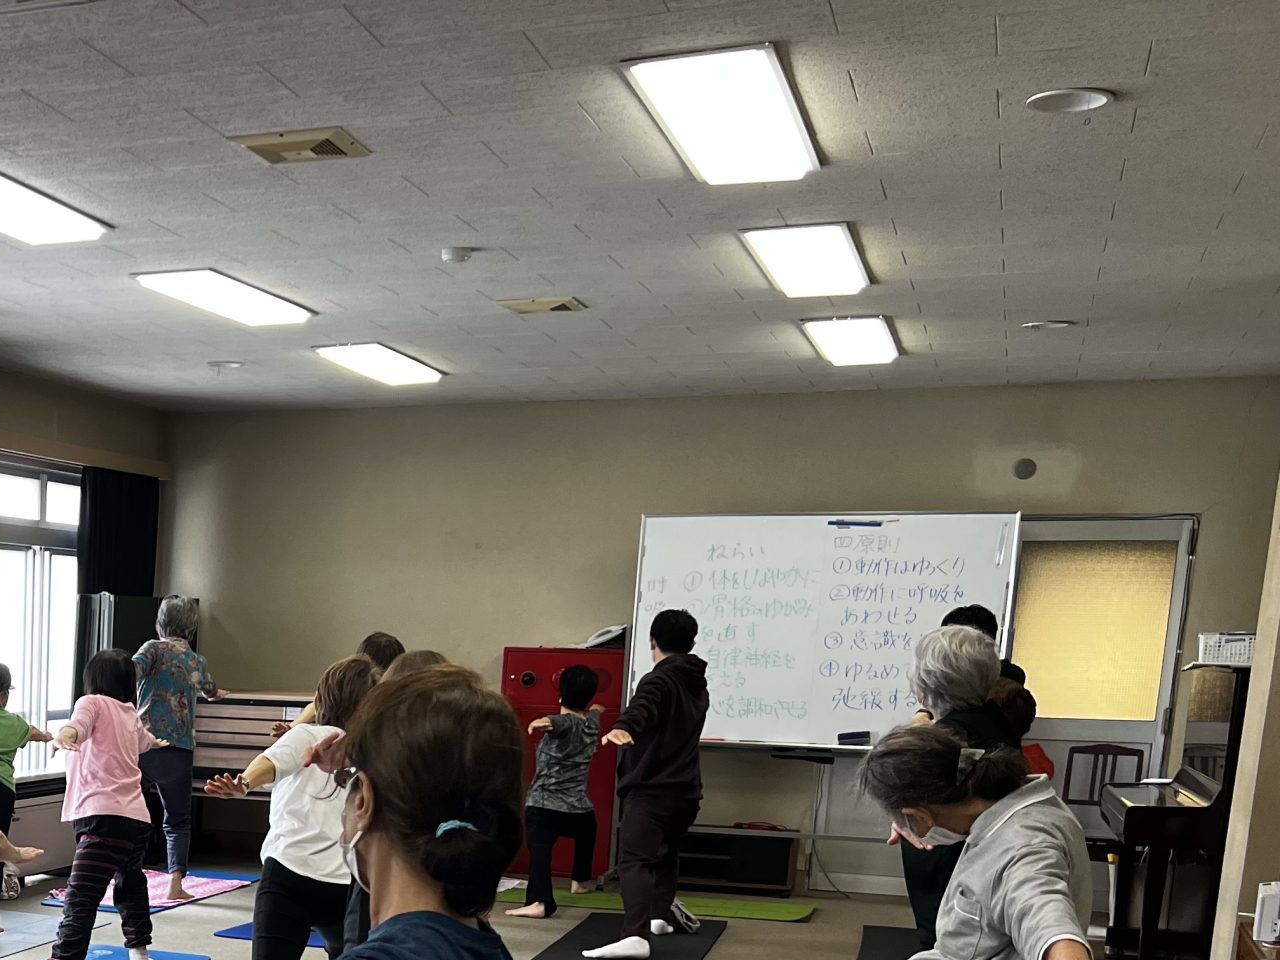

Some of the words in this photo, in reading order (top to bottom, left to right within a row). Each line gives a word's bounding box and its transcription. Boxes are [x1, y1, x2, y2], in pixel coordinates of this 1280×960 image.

[706, 543, 766, 561] ねらい
[834, 534, 901, 554] 四原則
[840, 606, 917, 626] あわせる
